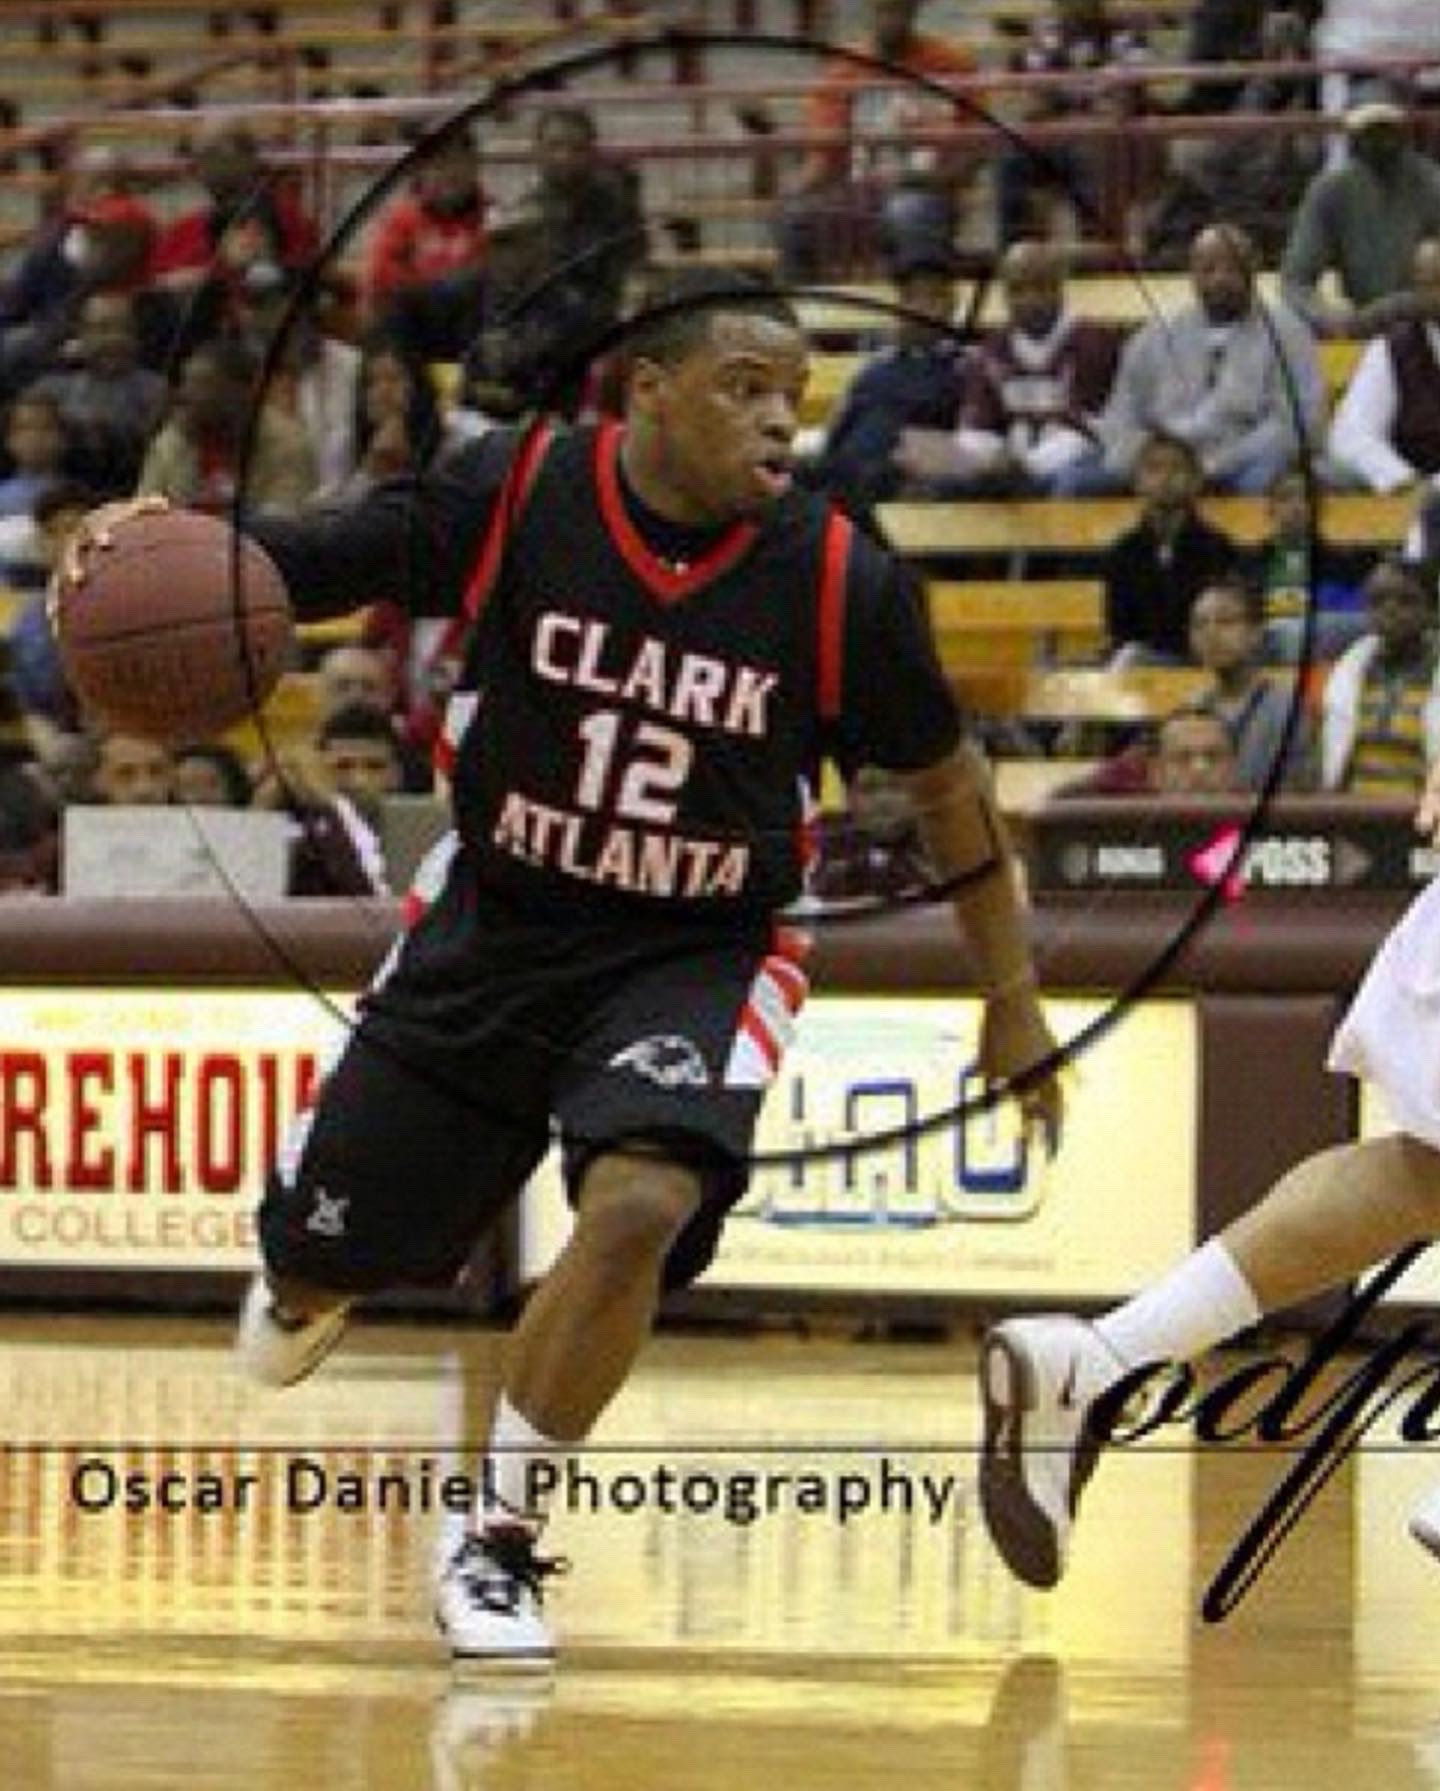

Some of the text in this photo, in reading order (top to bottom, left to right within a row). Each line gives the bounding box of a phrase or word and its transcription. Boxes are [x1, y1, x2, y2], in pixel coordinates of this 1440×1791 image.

[531, 612, 779, 735] CLARK
[576, 708, 695, 822] 12
[494, 792, 750, 897] ATLANTA
[14, 1204, 260, 1248] COLLEGE
